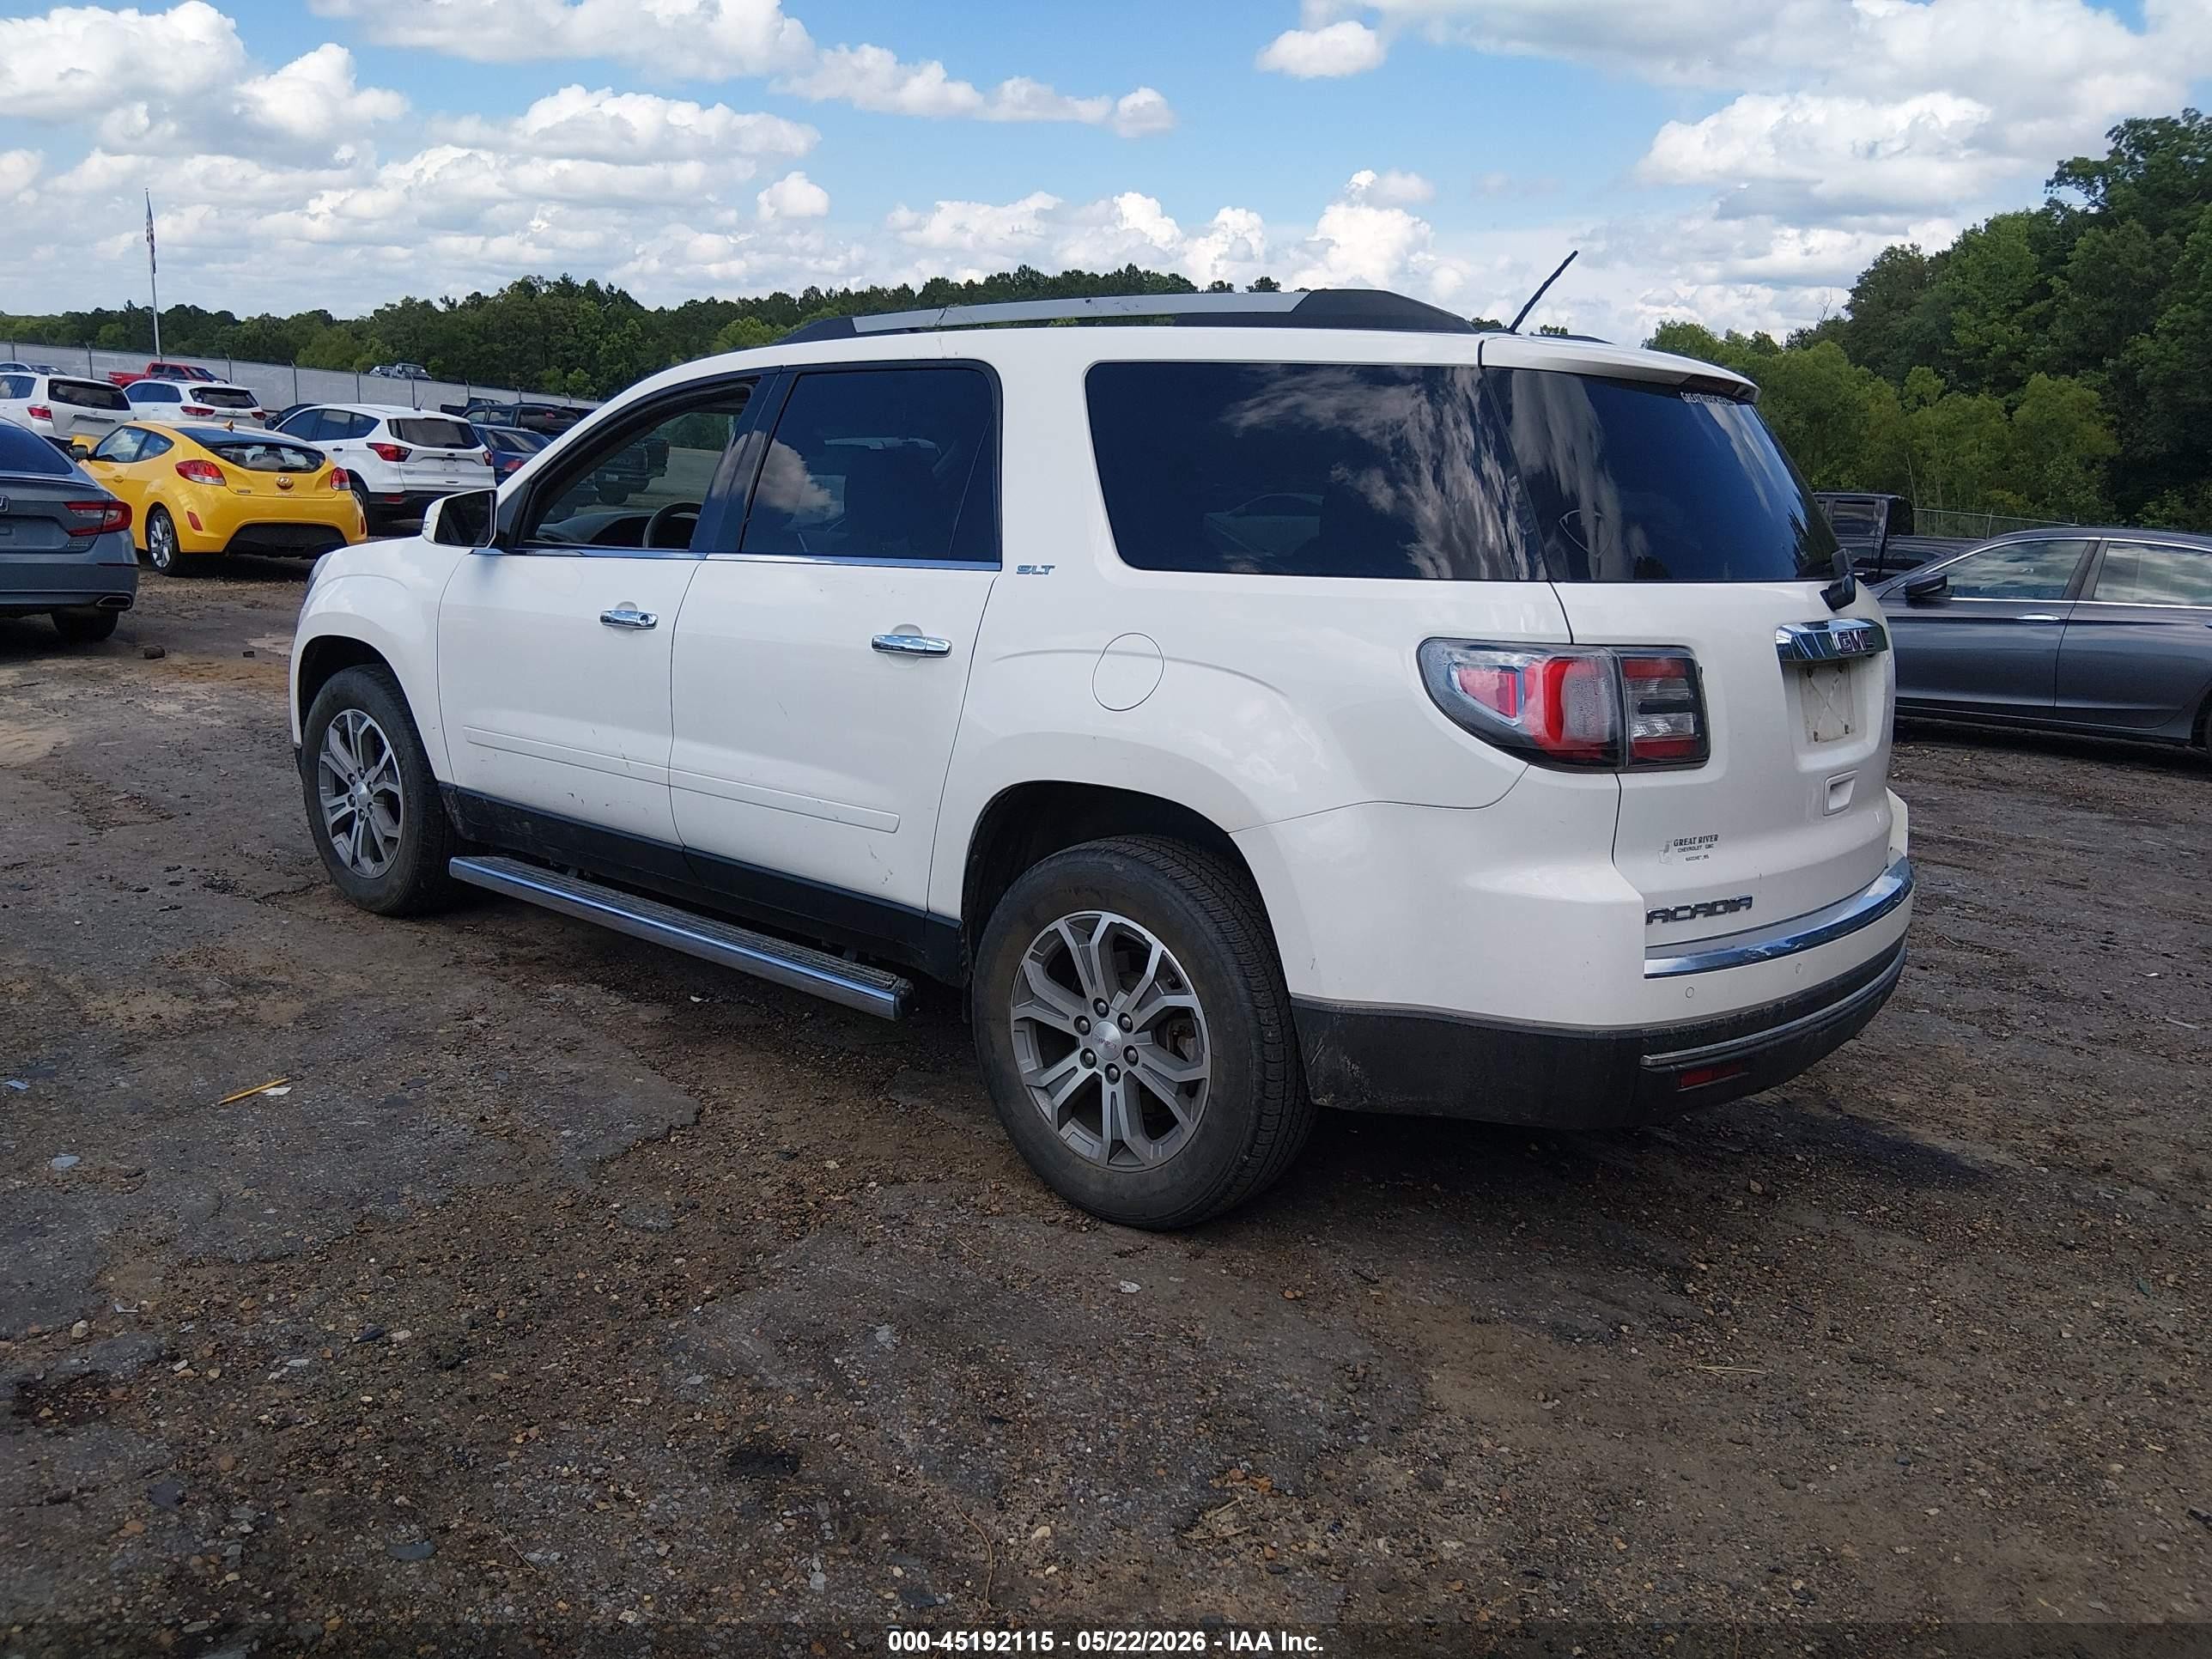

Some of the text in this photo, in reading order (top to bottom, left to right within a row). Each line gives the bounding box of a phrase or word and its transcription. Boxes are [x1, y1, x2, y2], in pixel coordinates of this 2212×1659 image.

[1016, 565, 1056, 575] SLT
[1835, 629, 1875, 654] GMC
[1674, 834, 1718, 847] GREAT RIVER
[1645, 895, 1753, 926] ACADIA
